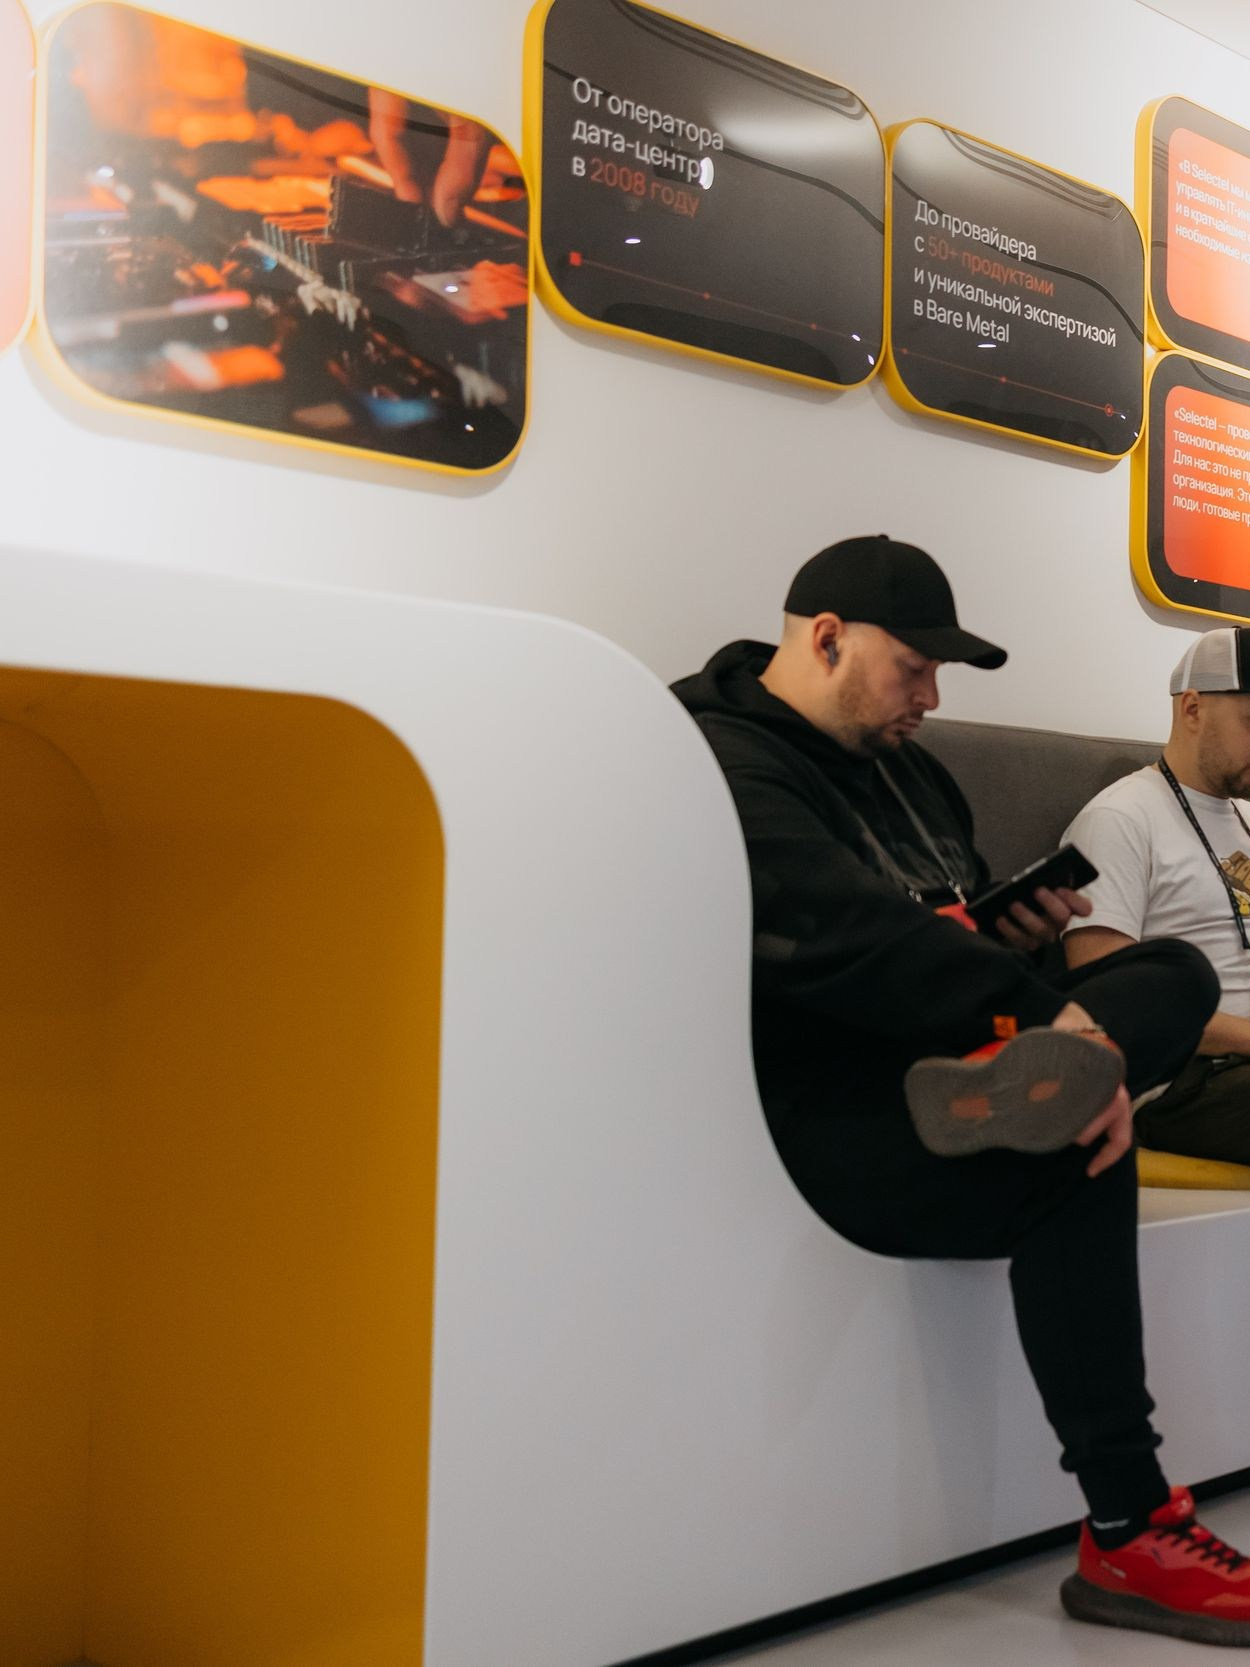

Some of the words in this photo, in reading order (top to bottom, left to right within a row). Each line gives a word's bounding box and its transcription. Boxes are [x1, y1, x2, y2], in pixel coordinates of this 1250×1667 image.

[572, 78, 603, 107] От
[607, 94, 724, 151] оператора
[572, 120, 712, 183] дата-центр
[572, 156, 586, 177] в
[590, 158, 647, 197] 2008
[650, 182, 700, 218] году
[1176, 181, 1225, 211] управлять
[1191, 164, 1230, 193] Selectel
[915, 200, 939, 225] До
[942, 213, 1037, 261] провайдера
[1176, 225, 1240, 259] необходимые
[915, 236, 925, 252] с
[928, 236, 958, 260] 50+
[961, 250, 1055, 296] продуктами
[914, 267, 924, 284] и
[927, 271, 1021, 316] уникальной
[1024, 305, 1117, 347] экспертизой
[914, 300, 923, 316] в
[927, 299, 963, 328] Bare
[966, 312, 1010, 343] Metal
[1173, 450, 1192, 466] Для
[1193, 458, 1211, 471] нас
[1212, 462, 1229, 476] это
[1230, 468, 1242, 480] не
[1173, 474, 1236, 500] организация.
[1173, 496, 1201, 513] люди,
[1202, 505, 1241, 522] готовые
